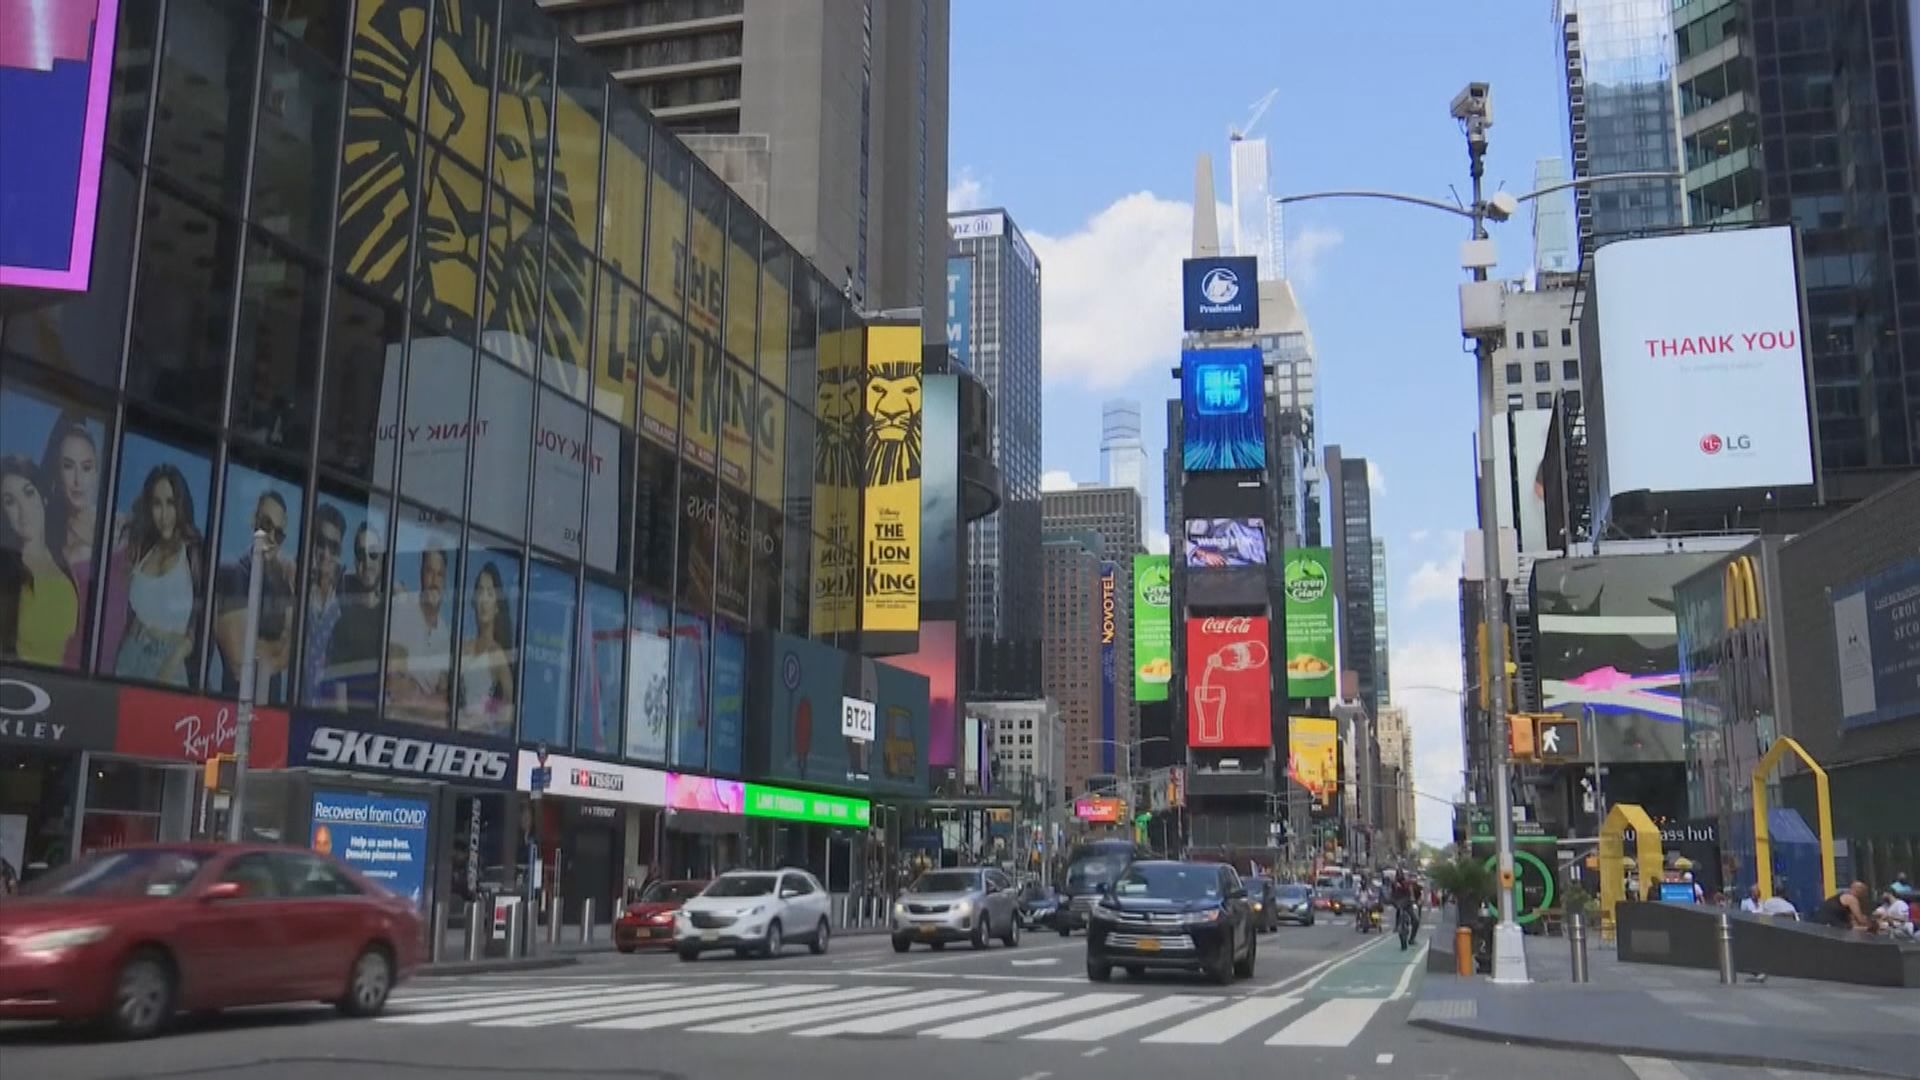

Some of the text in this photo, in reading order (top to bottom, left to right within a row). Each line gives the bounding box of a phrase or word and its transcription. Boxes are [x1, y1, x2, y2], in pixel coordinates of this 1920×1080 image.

[672, 237, 722, 318] THE
[1200, 303, 1242, 314] Prudential
[608, 257, 777, 451] LION KING
[1645, 329, 1796, 358] THANK YOU
[1726, 434, 1751, 450] LG
[875, 523, 905, 538] THE
[869, 541, 911, 565] LION
[866, 567, 916, 597] KING
[1288, 579, 1324, 593] Green
[1101, 570, 1114, 644] NOVOTEL
[845, 705, 873, 732] BT21
[175, 707, 257, 757] Ray-Ba
[306, 726, 511, 781] SKECHERS
[315, 801, 427, 825] Recovered from COVID?
[351, 836, 369, 850] Help
[369, 839, 379, 849] us
[379, 839, 394, 849] save
[467, 797, 482, 892] SKECHERS
[1619, 826, 1715, 842] suass hut
[345, 847, 371, 861] Donate
[371, 849, 398, 863] plasma
